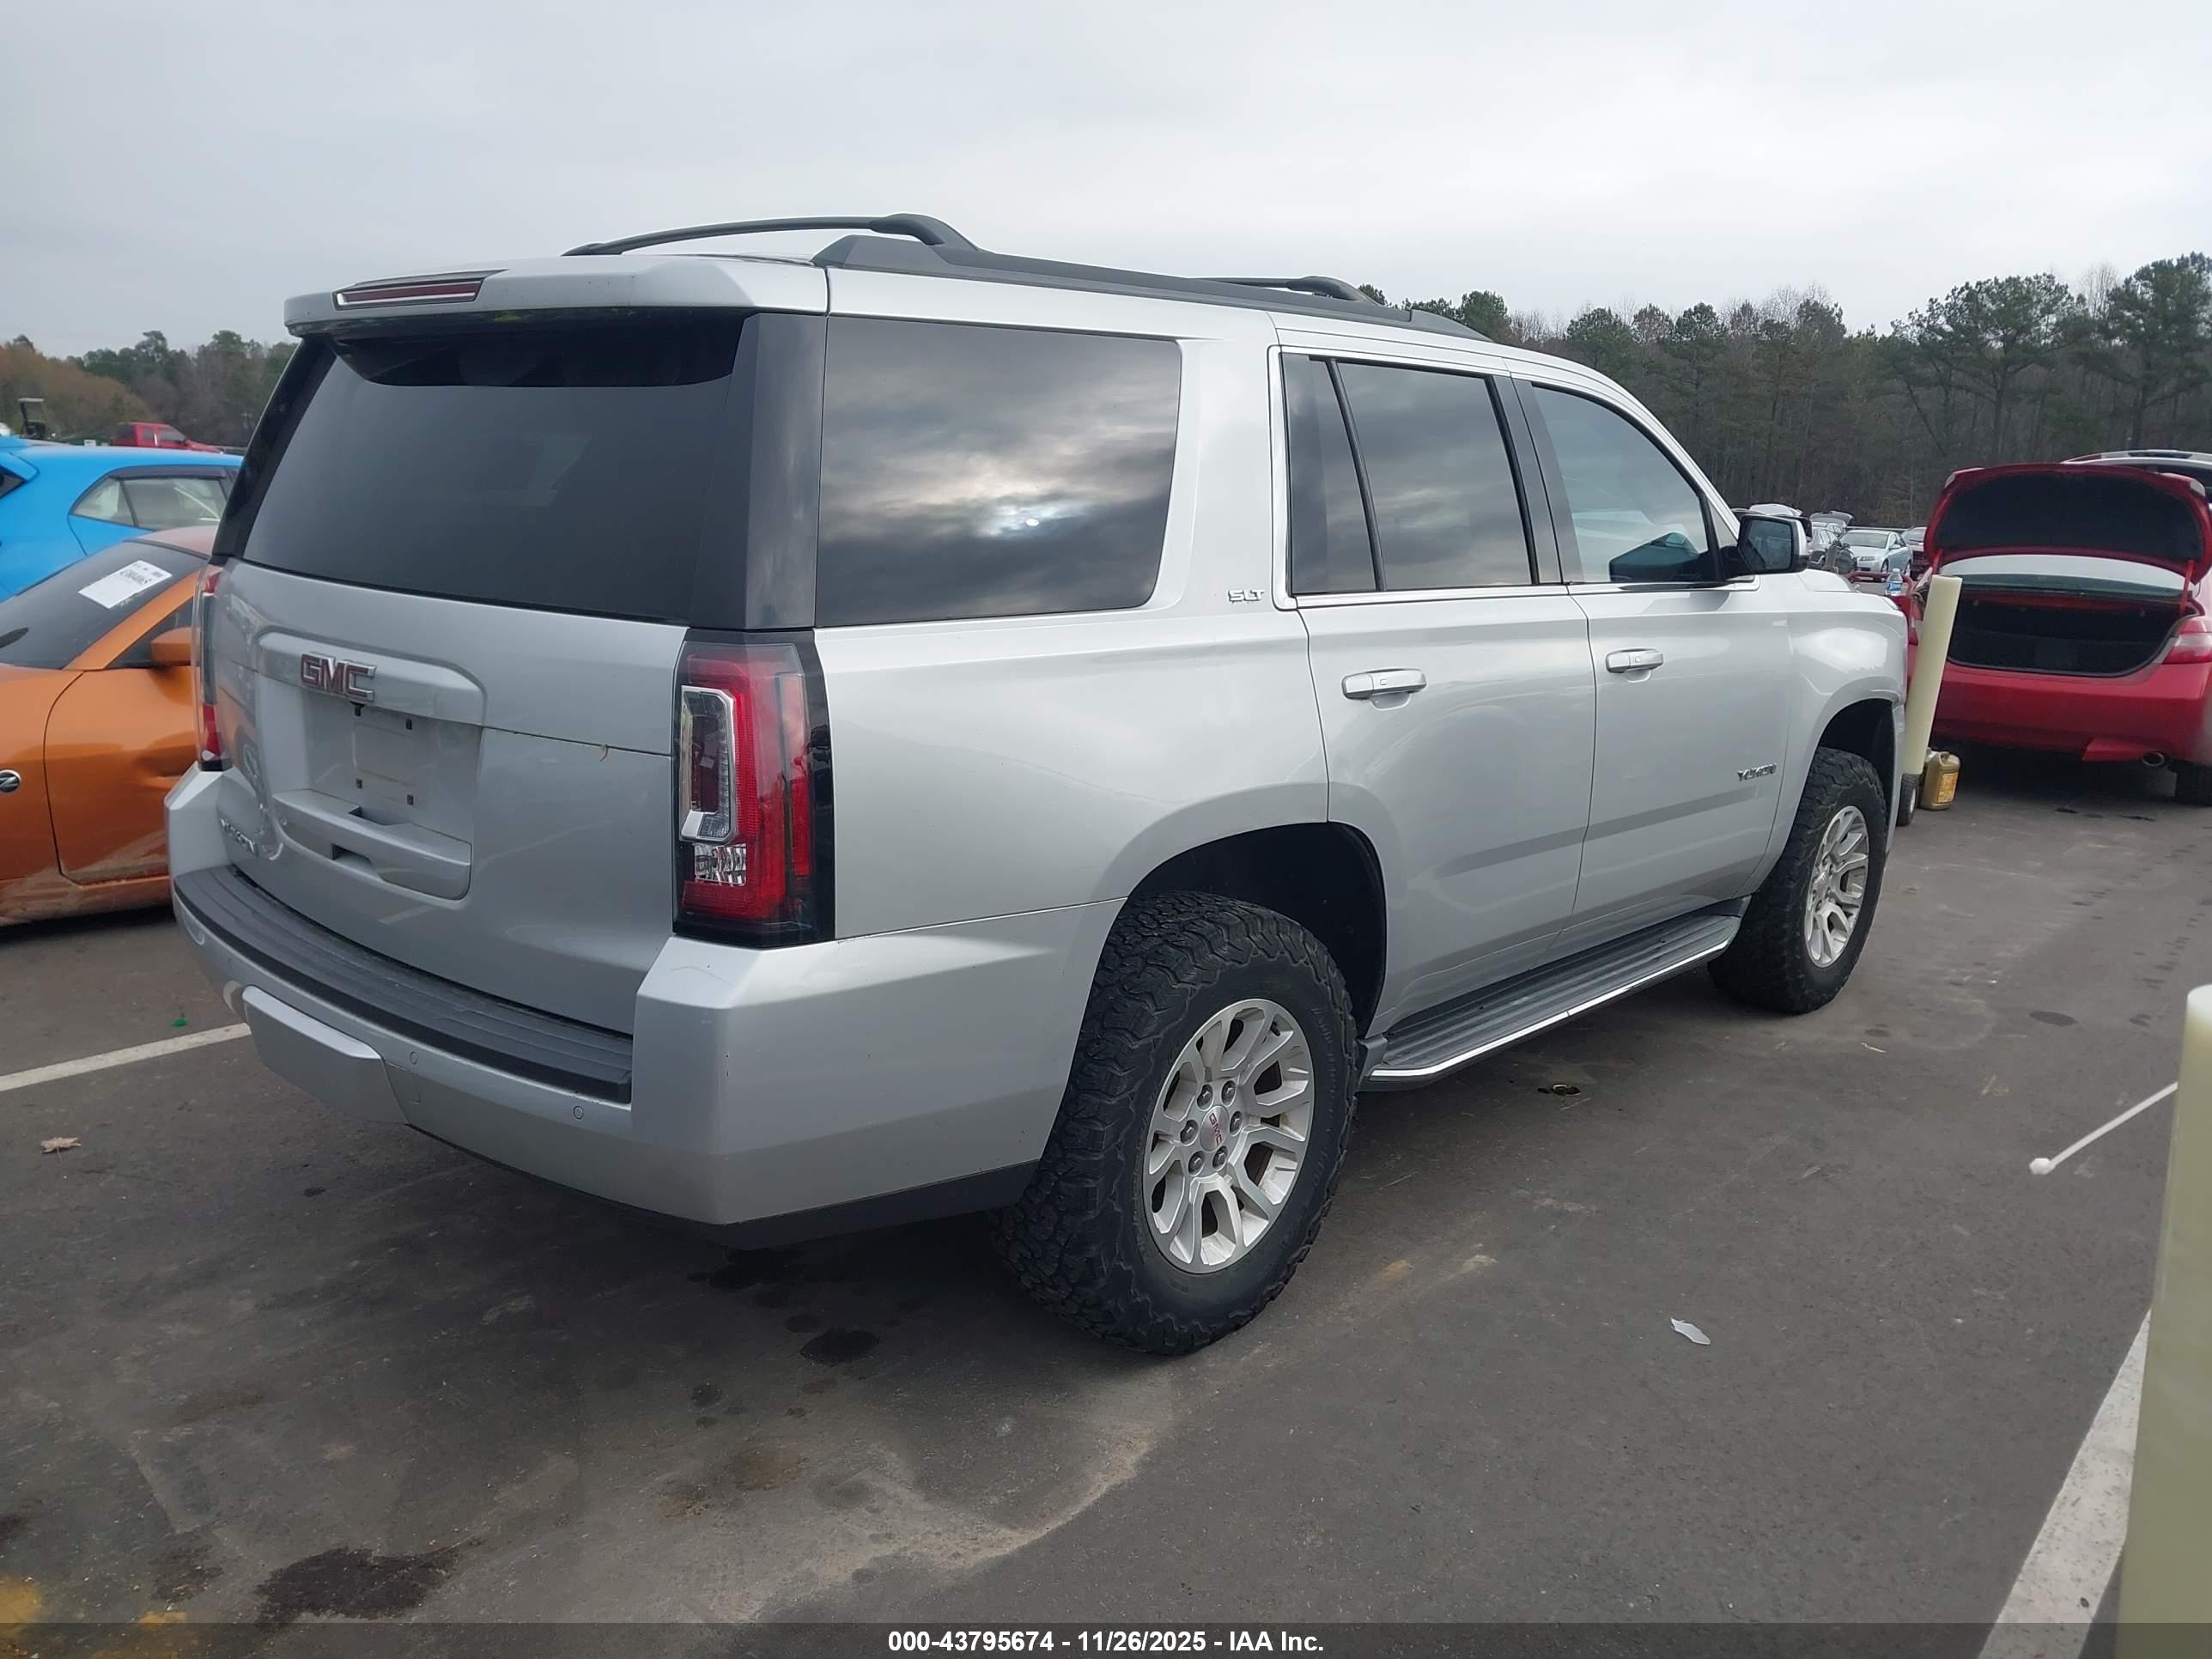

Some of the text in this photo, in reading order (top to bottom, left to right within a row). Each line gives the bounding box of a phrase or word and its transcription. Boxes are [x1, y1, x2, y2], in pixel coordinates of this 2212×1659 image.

[1228, 588, 1265, 603] SLT
[301, 652, 376, 702] GMC
[1208, 1112, 1223, 1146] GMC
